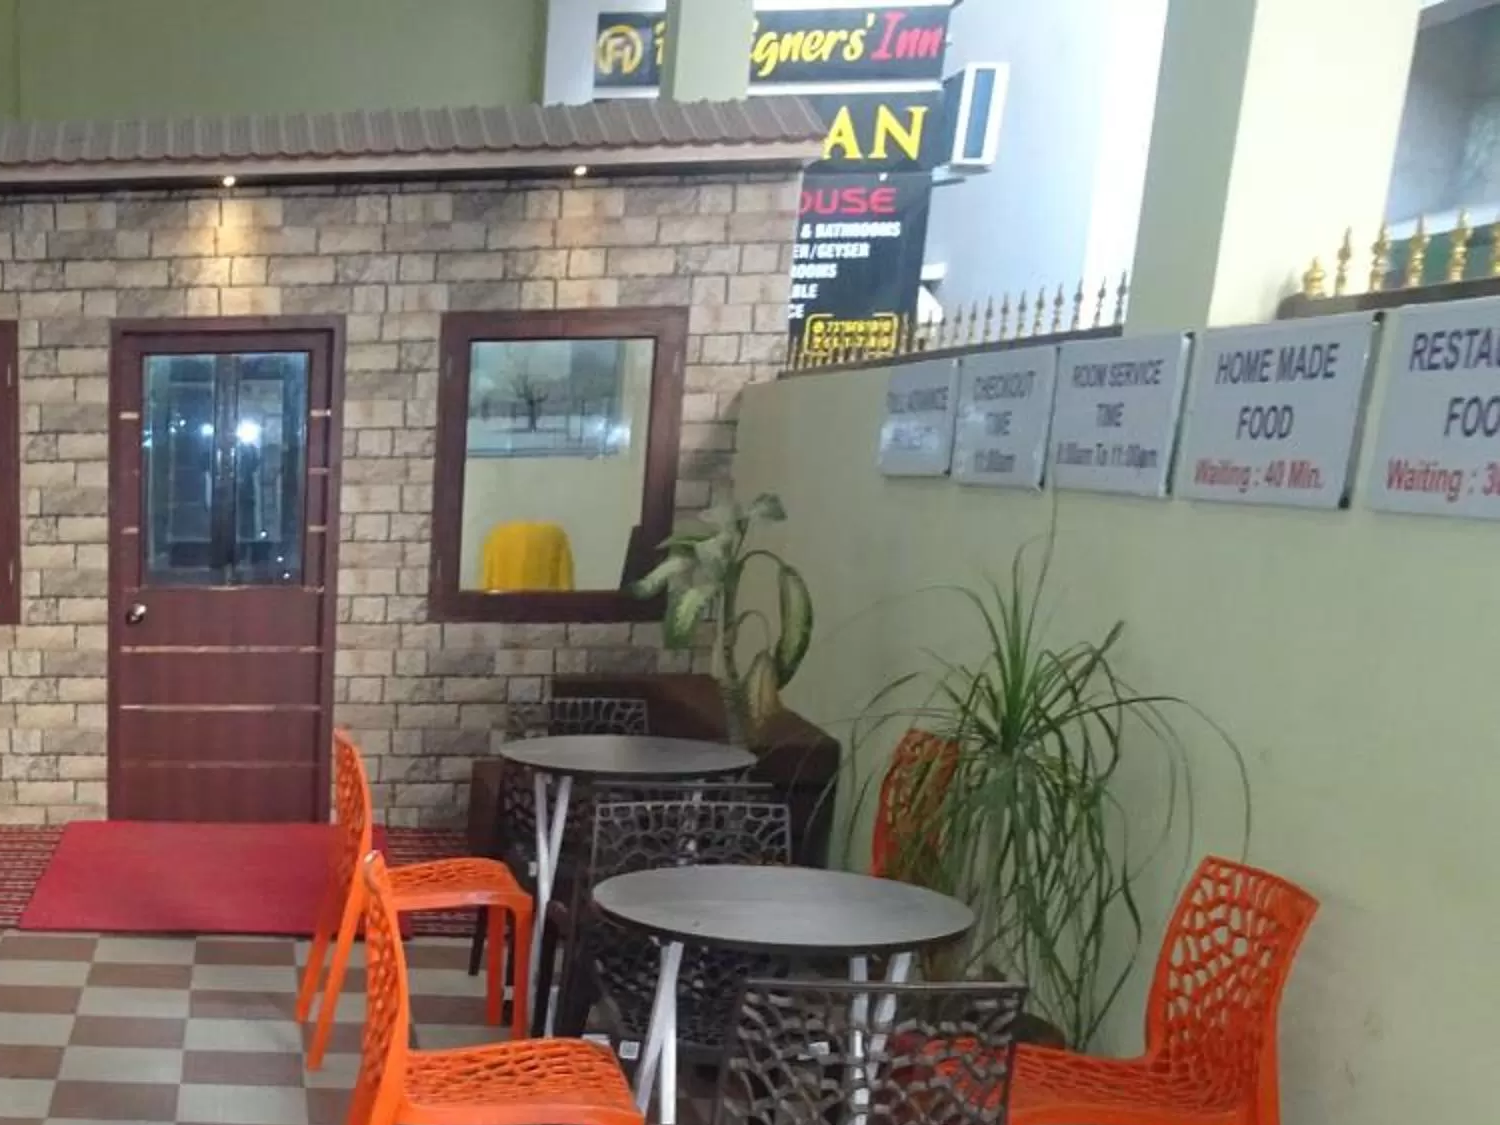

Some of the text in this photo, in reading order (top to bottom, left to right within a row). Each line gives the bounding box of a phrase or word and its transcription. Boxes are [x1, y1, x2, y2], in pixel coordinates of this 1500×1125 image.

[870, 11, 945, 61] Inn
[1073, 359, 1164, 388] ROOM SERVICE
[1214, 342, 1340, 385] HOME MADE
[1235, 404, 1295, 440] FOOD
[1194, 457, 1252, 494] Waiting
[1386, 456, 1463, 503] Waiting
